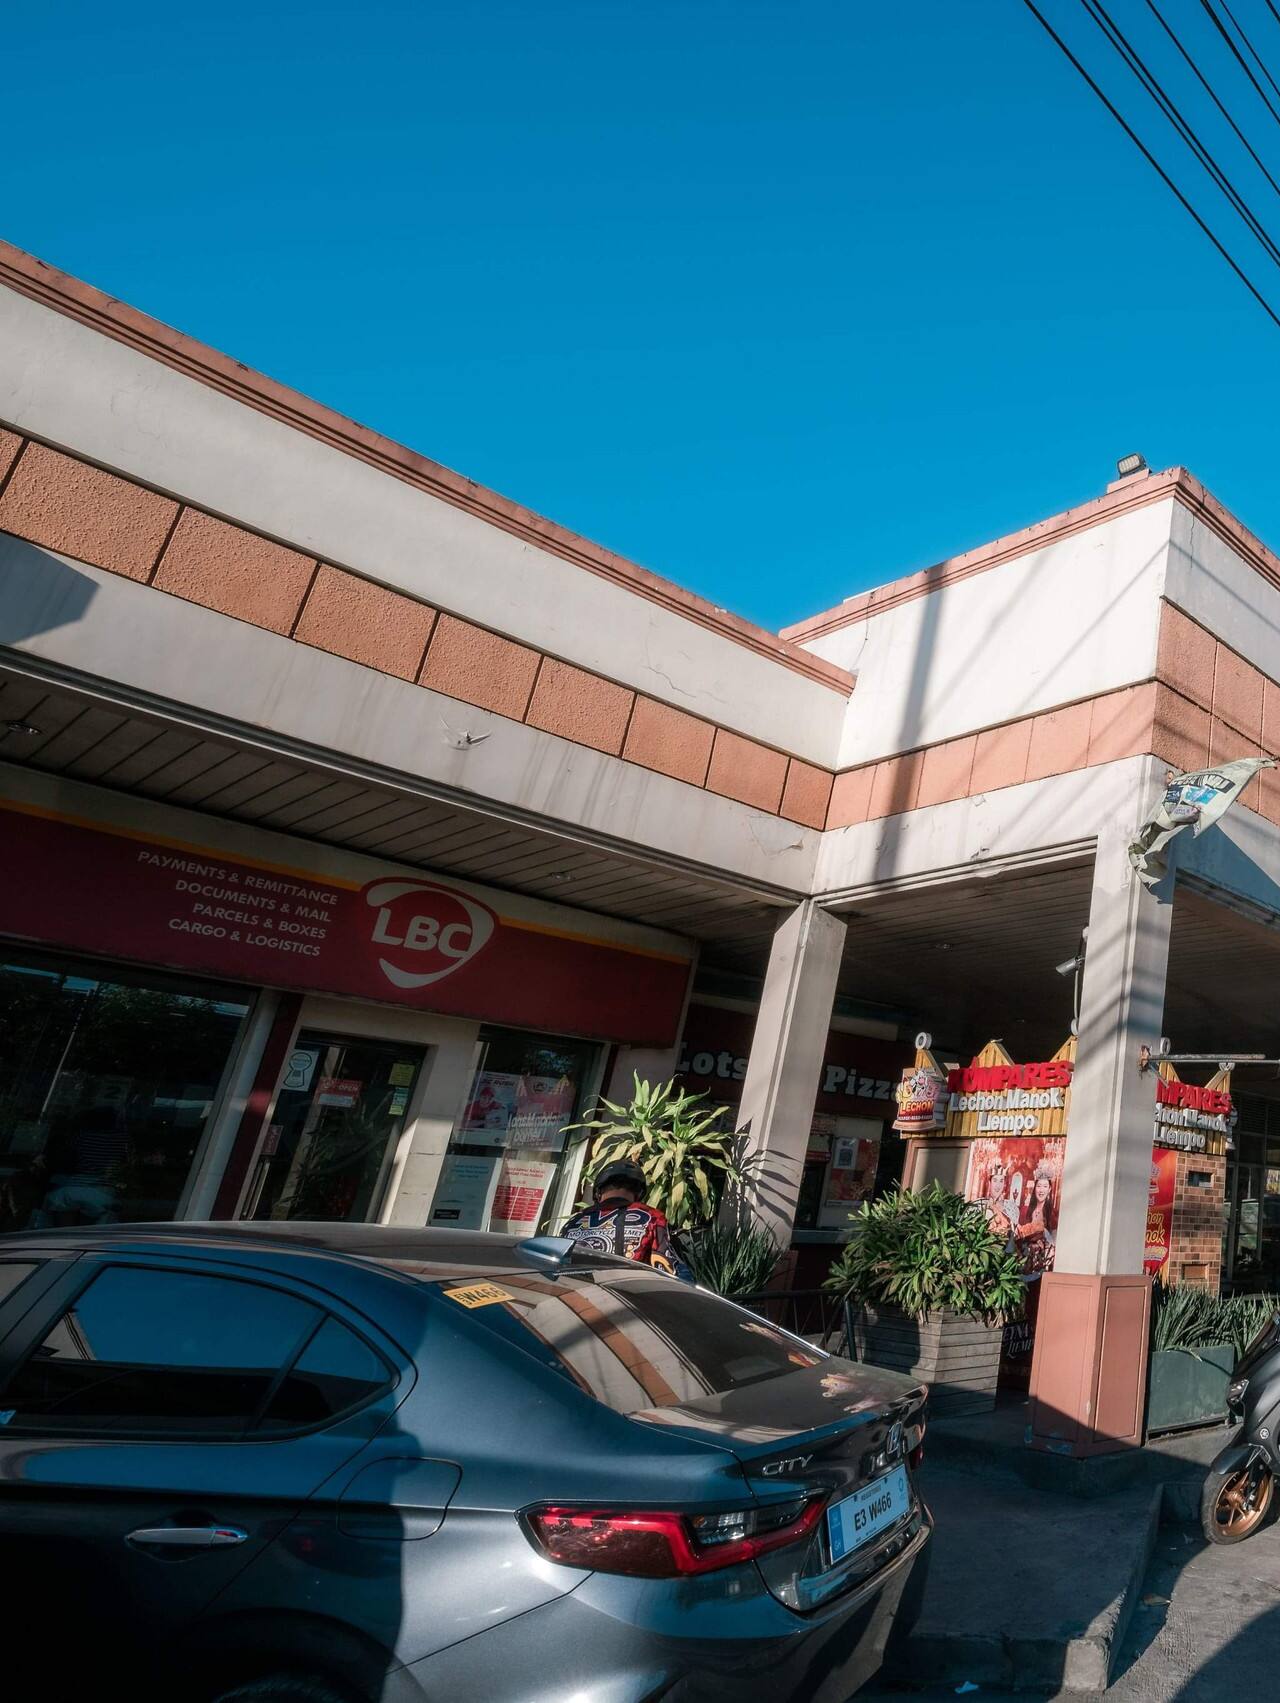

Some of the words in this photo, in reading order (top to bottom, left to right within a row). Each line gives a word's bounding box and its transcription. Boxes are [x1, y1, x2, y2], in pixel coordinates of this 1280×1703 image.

[137, 850, 226, 881] PAYMENTS
[228, 872, 240, 883] &
[244, 875, 338, 905] REMITTANCE
[175, 879, 277, 911] DOCUMENTS
[280, 903, 291, 914] &
[294, 905, 332, 923] MAIL
[168, 918, 227, 939] CARGO
[230, 930, 241, 941] &
[246, 933, 321, 957] LOGISTICS
[192, 903, 259, 926] PARCELS
[263, 917, 274, 929] &
[278, 920, 327, 939] BOXES
[371, 906, 473, 960] LBC
[823, 1065, 897, 1101] Pizz
[949, 1091, 1006, 1112] Lechon
[1006, 1087, 1063, 1109] Manok
[977, 1111, 1037, 1136] Liempo
[569, 1229, 615, 1238] MOTORCYCLE
[762, 1454, 814, 1477] CITY
[854, 1508, 868, 1531] E3
[868, 1491, 893, 1521] W466
